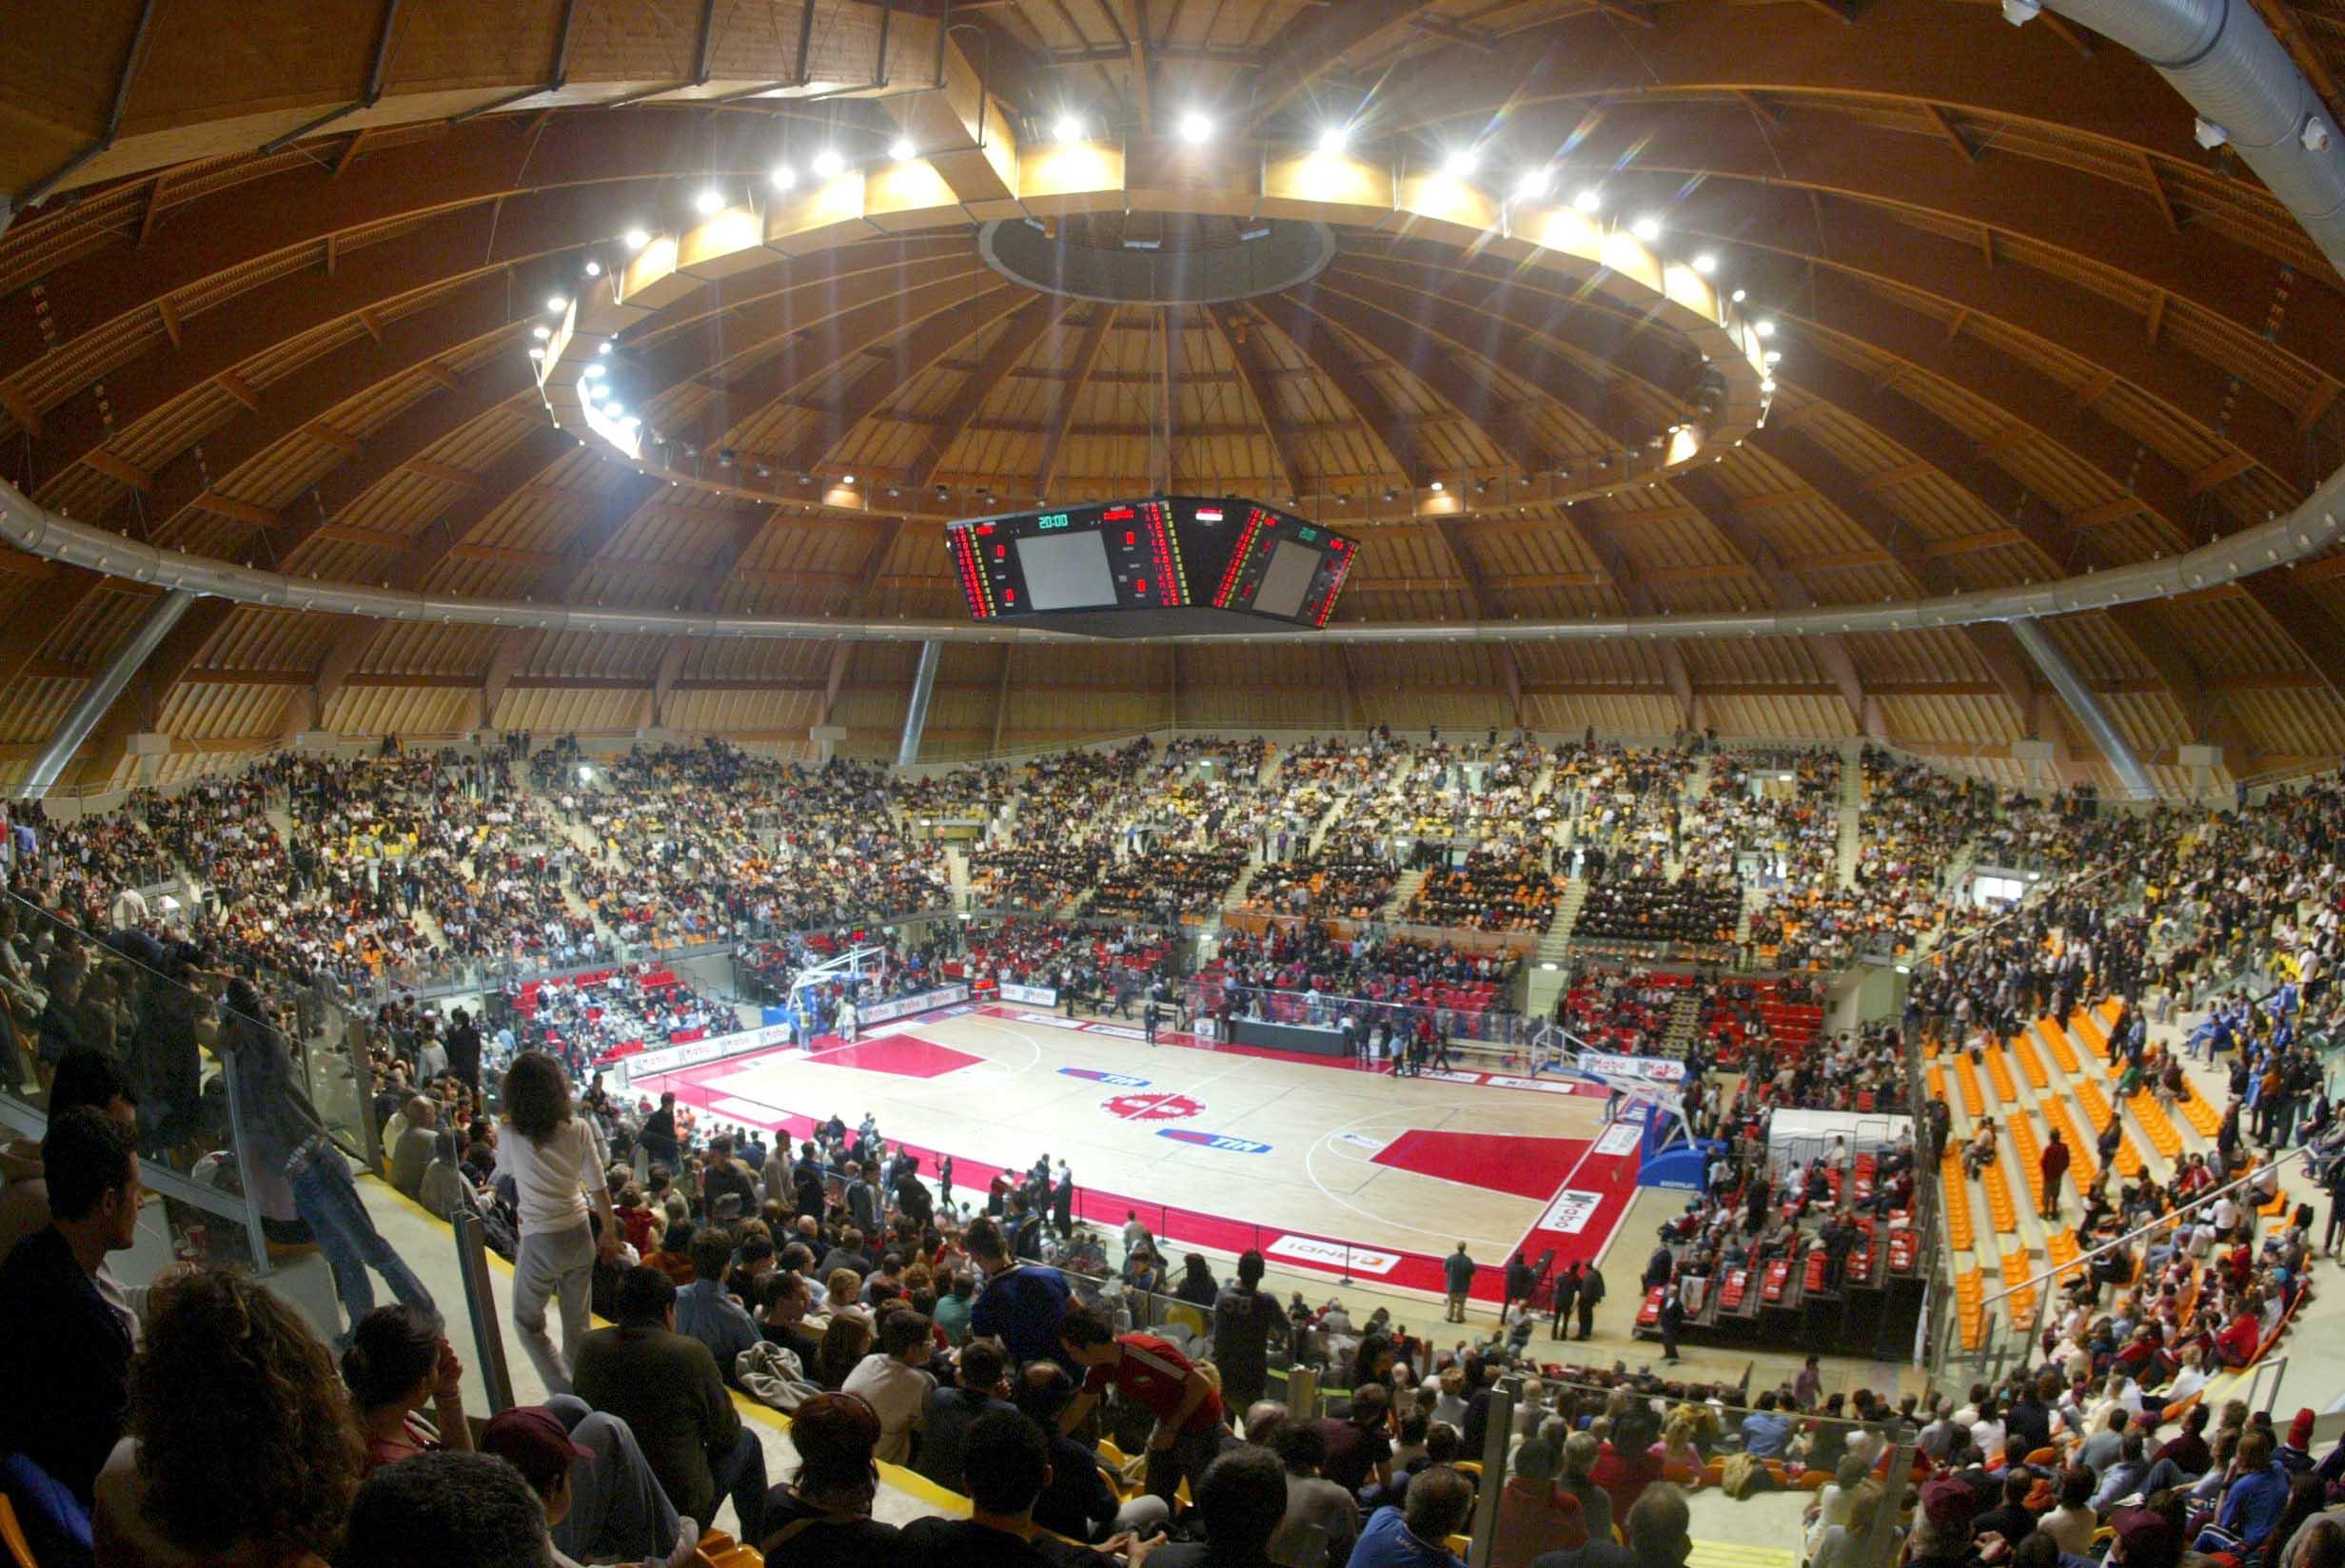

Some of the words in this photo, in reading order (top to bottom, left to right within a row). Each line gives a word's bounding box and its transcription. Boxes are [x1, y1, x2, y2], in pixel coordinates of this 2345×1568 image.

[1039, 514, 1068, 529] 20:00
[1211, 1137, 1261, 1152] TIM
[1554, 1200, 1586, 1228] Mabo
